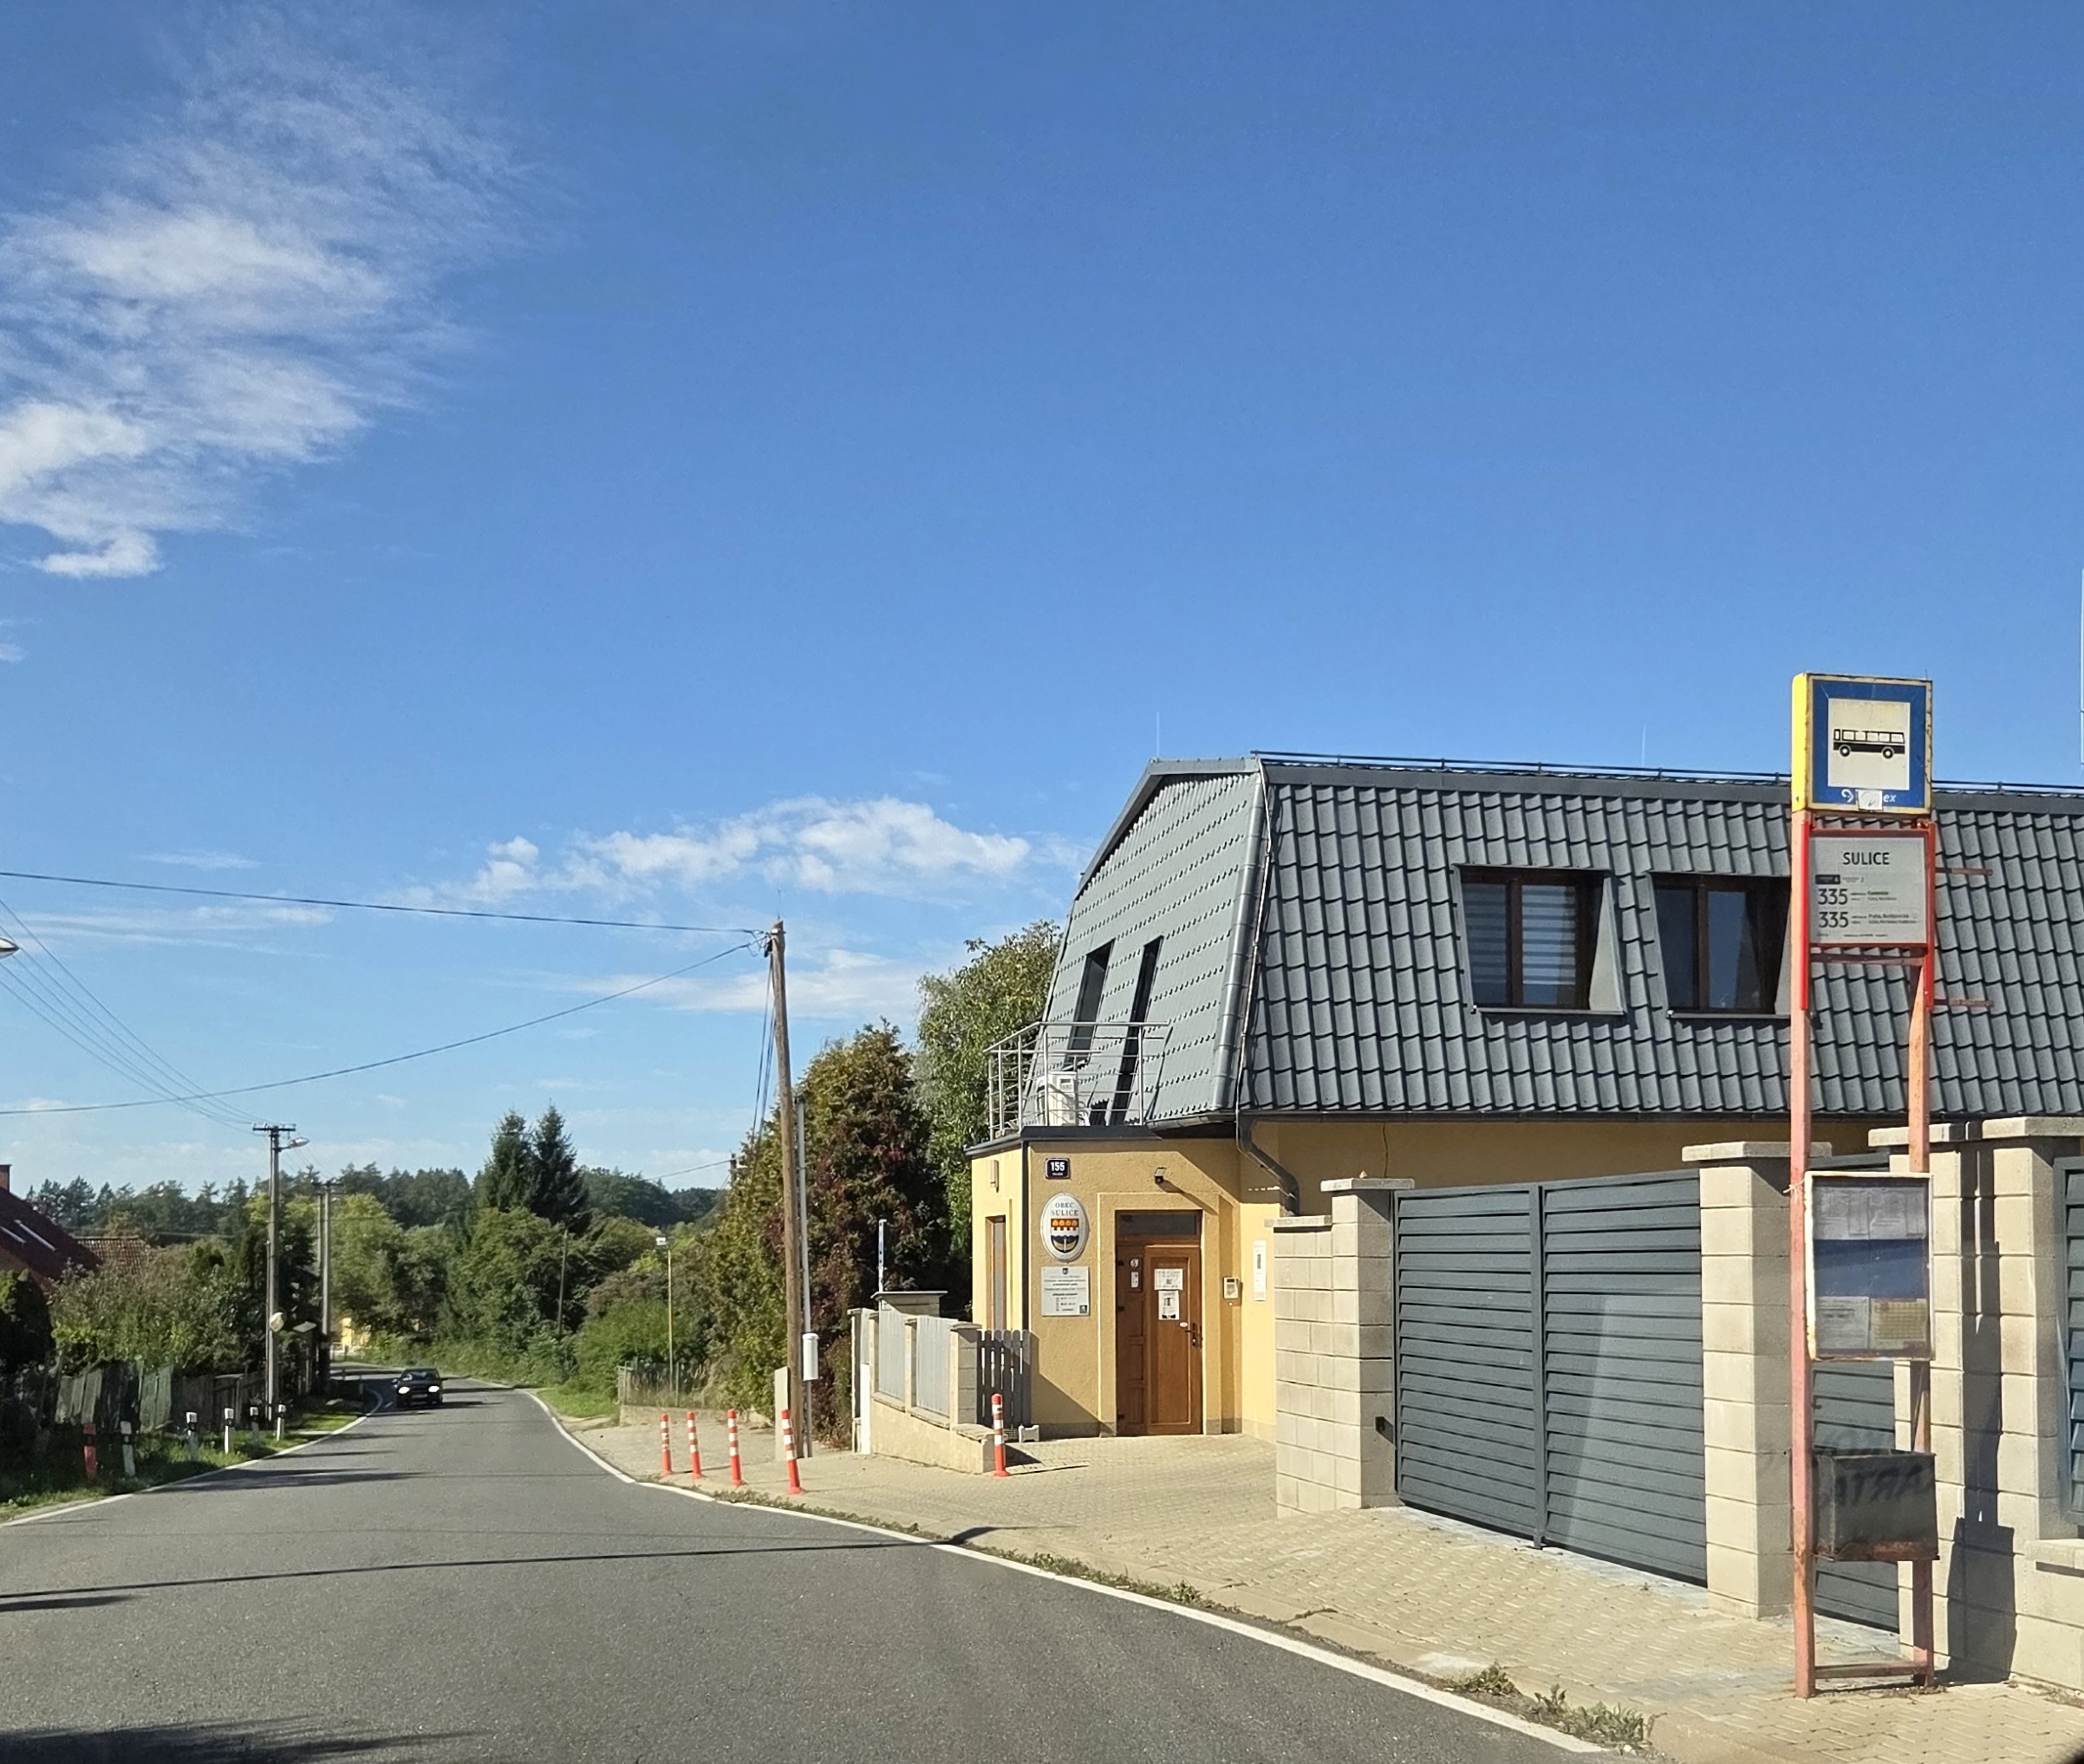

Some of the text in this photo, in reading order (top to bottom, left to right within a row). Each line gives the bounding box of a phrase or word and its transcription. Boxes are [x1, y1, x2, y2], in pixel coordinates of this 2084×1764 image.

[1842, 852, 1890, 865] SULICE
[1817, 888, 1848, 905] 335
[1818, 911, 1849, 928] 335
[1051, 1162, 1065, 1172] 155
